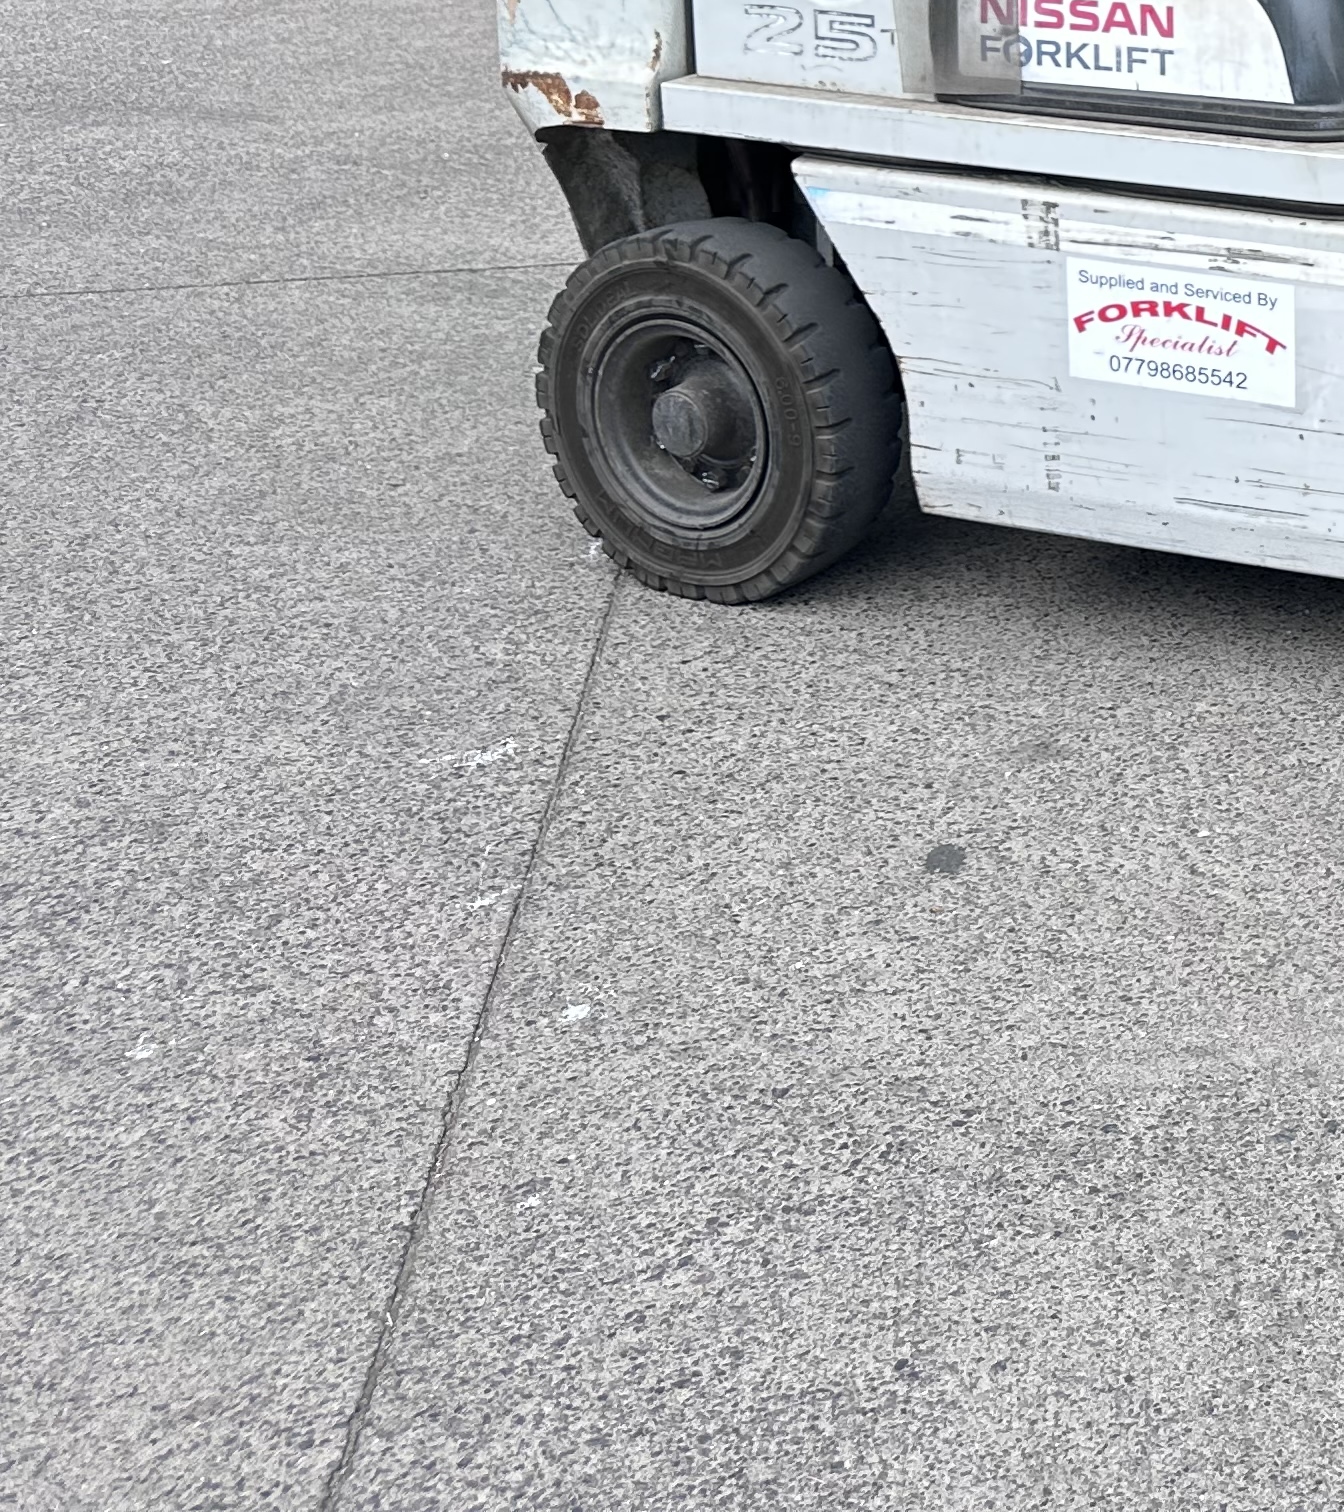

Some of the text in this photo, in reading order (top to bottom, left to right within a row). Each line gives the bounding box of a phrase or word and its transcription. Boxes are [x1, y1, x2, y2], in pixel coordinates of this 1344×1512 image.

[980, 34, 1175, 76] FORKLIFT
[1078, 269, 1278, 310] Supplied and Serviced By
[1073, 300, 1288, 355] FORKLIFT
[1115, 323, 1239, 358] Specialist
[1109, 354, 1249, 390] 07798685542
